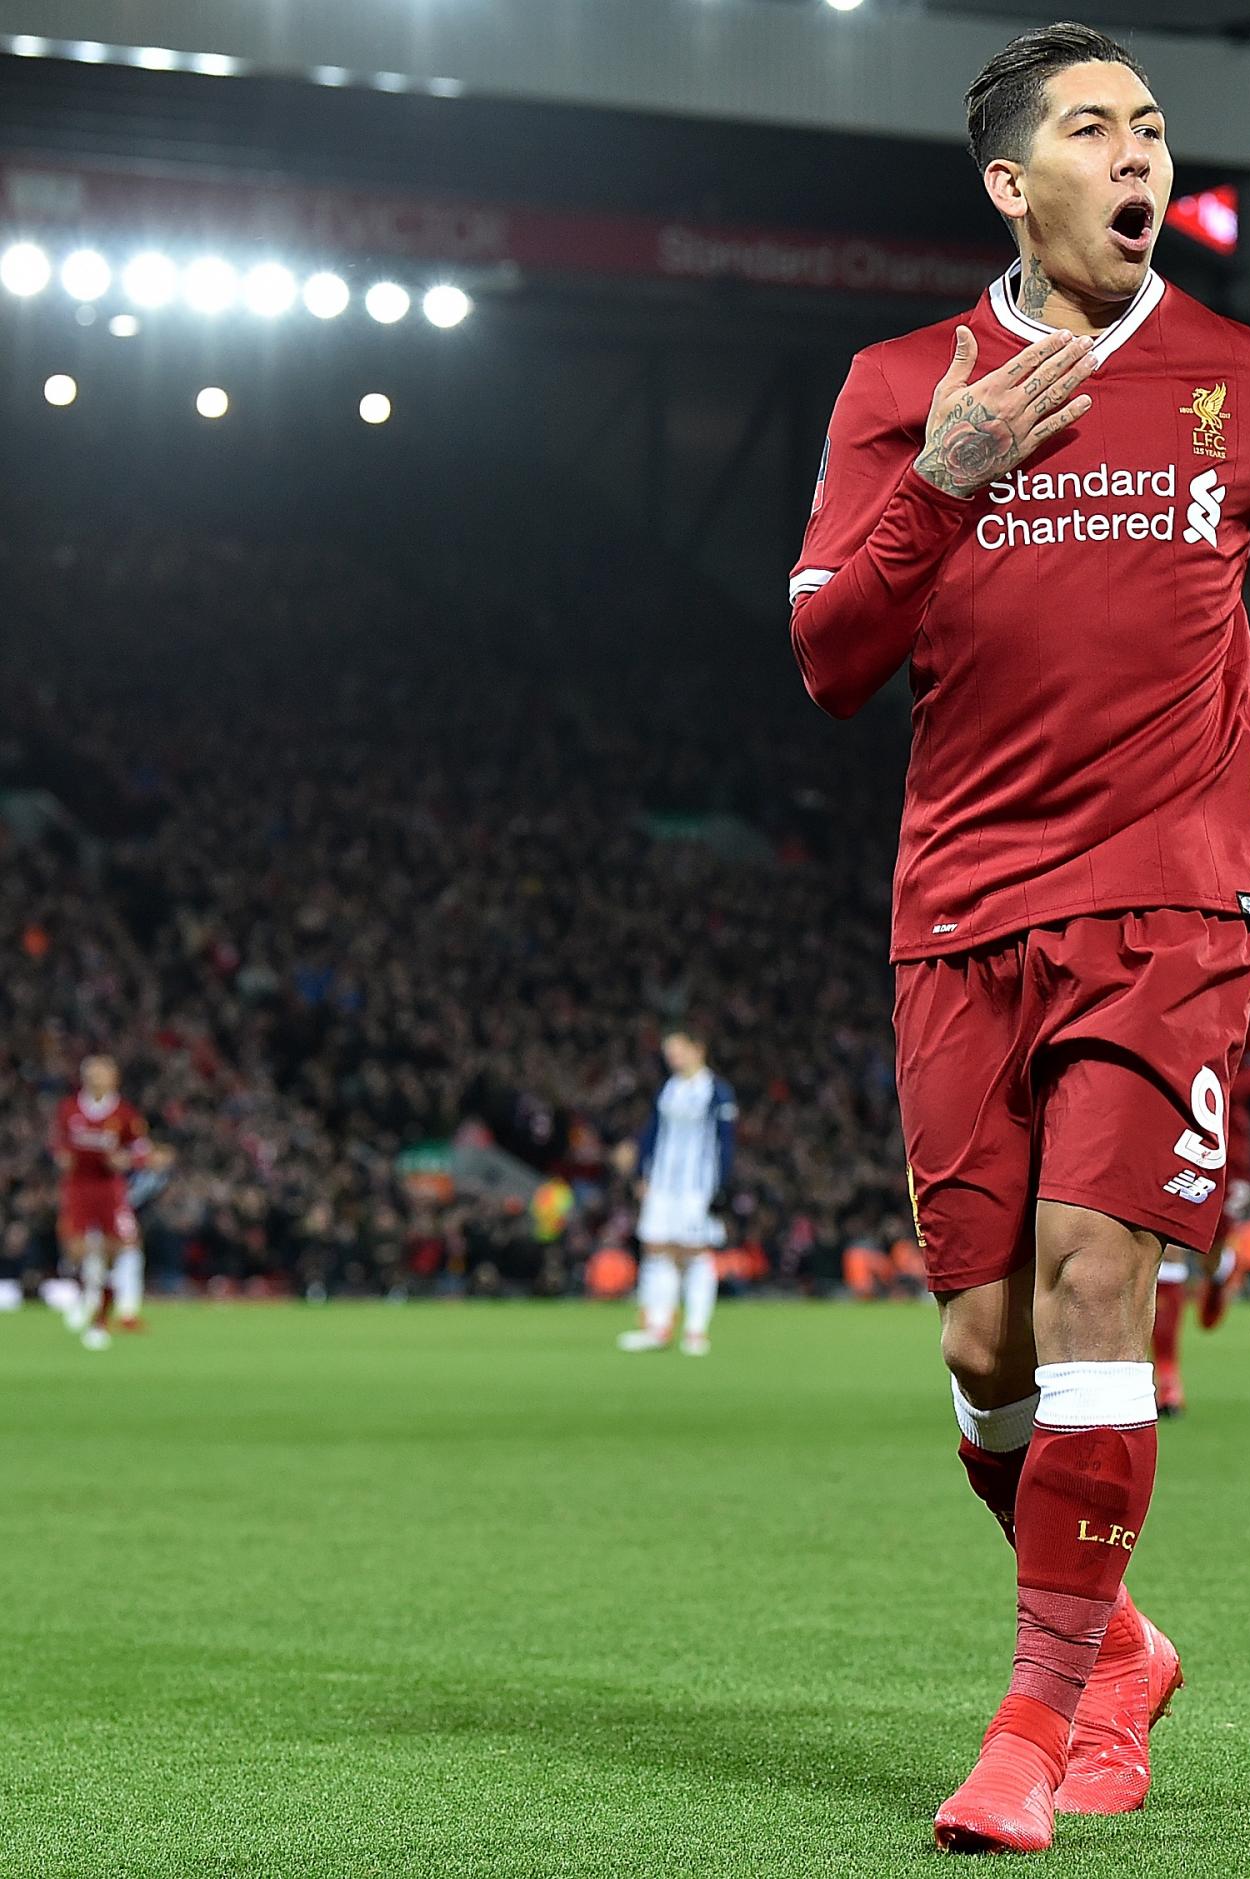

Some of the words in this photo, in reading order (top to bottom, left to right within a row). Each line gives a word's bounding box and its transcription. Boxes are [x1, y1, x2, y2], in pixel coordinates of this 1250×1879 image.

[988, 463, 1175, 504] Standard
[976, 506, 1175, 550] Chartered
[1173, 1065, 1226, 1170] 9
